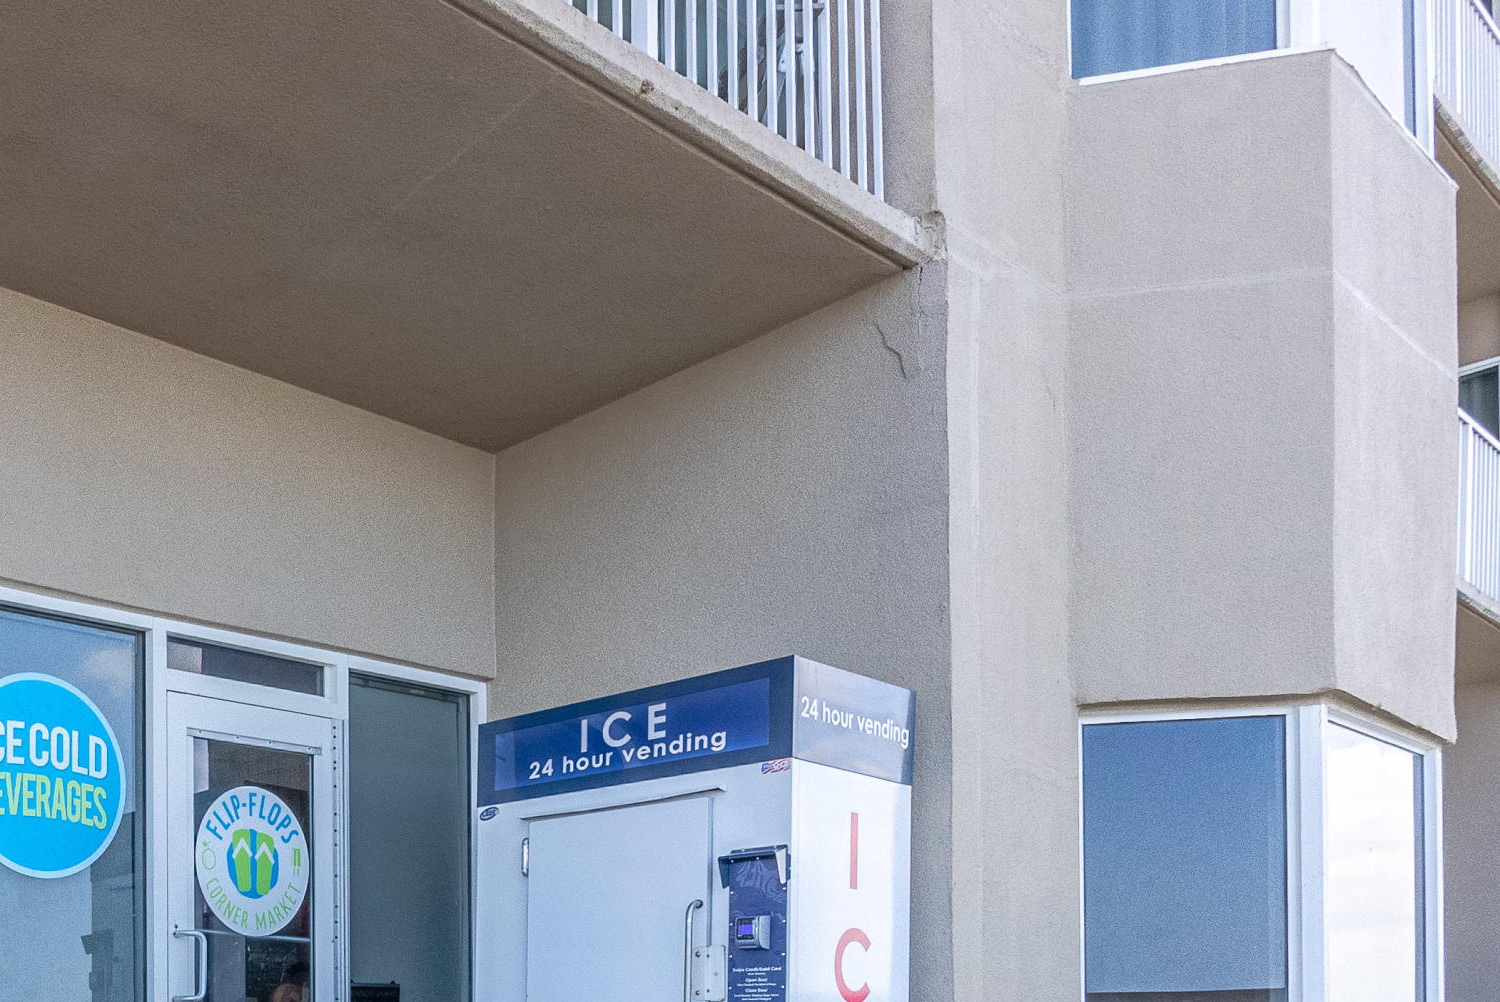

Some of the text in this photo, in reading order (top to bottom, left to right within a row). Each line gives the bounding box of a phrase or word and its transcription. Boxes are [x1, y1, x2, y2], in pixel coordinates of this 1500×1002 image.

[580, 702, 668, 754] ICE
[800, 695, 910, 750] 24 hour vending
[29, 723, 108, 779] COLD
[528, 727, 728, 780] 24 hour vending
[205, 792, 300, 844] FLIP-FLOPS
[205, 878, 302, 931] CORNER MARKET
